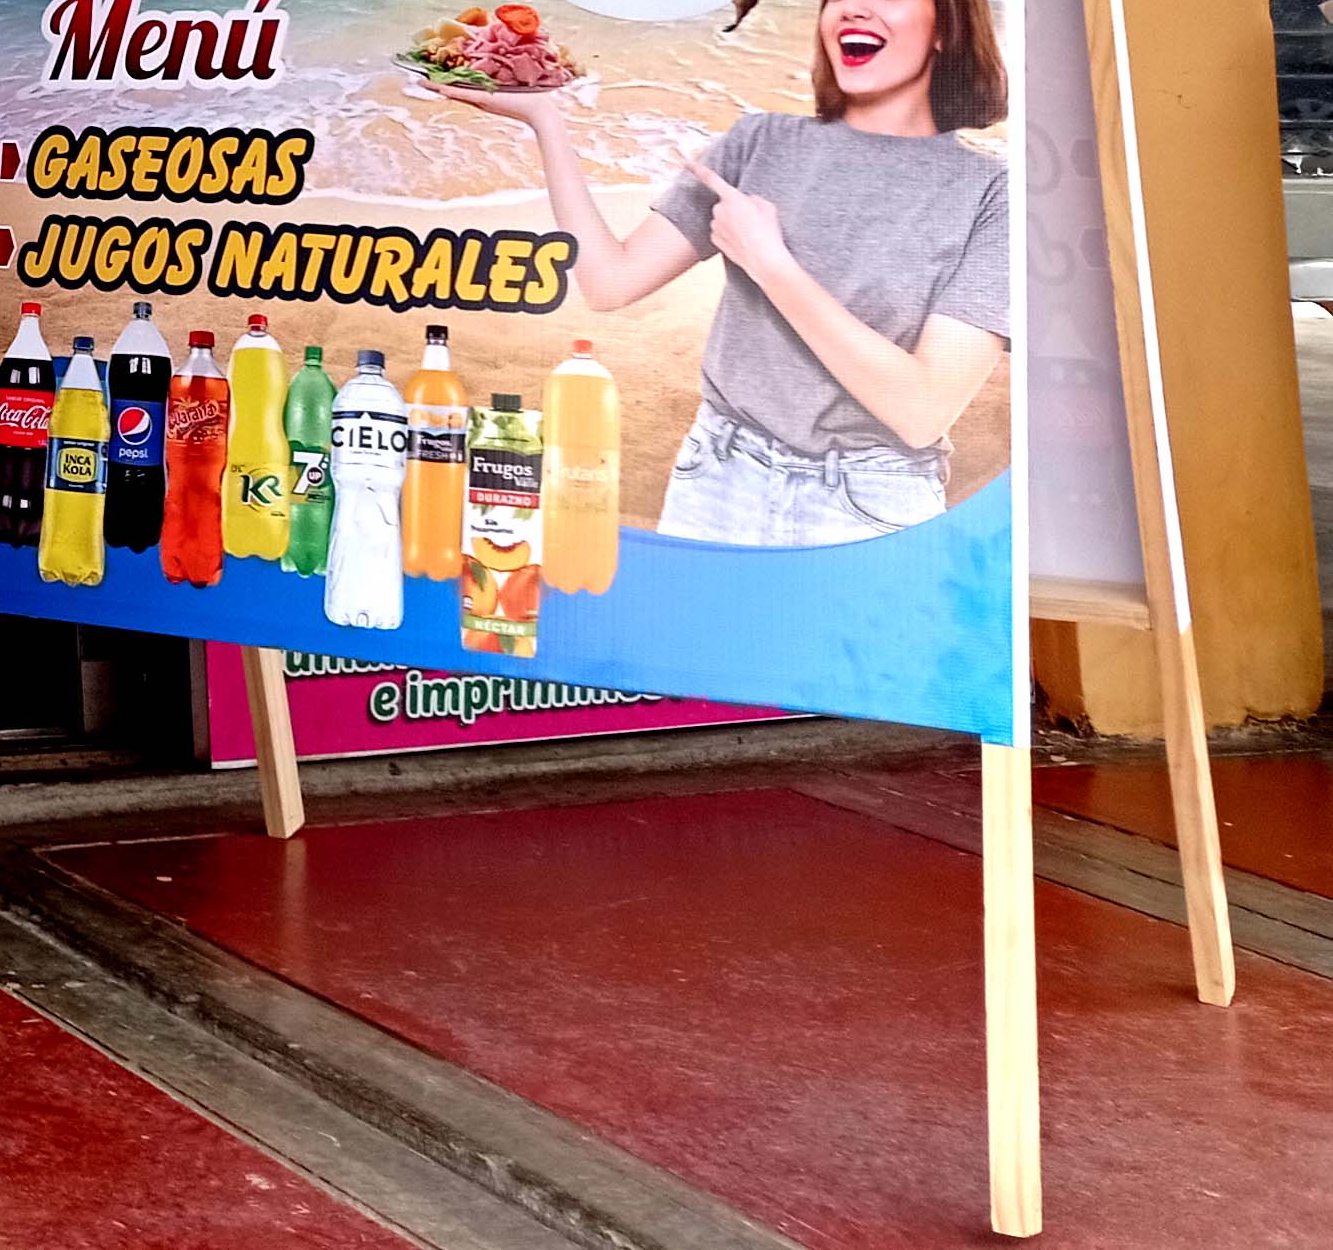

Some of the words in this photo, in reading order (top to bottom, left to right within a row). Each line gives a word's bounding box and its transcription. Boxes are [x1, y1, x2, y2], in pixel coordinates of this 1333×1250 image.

[32, 132, 309, 200] GASEOSAS
[21, 223, 207, 287] JUGOS
[217, 230, 573, 309] NATURALES
[331, 425, 407, 453] CIELO
[65, 453, 91, 466] INCA
[118, 447, 149, 460] pepsi
[63, 463, 92, 477] KOLA
[473, 456, 534, 481] Frugos
[476, 491, 533, 506] DURAZNO
[372, 684, 400, 721] e
